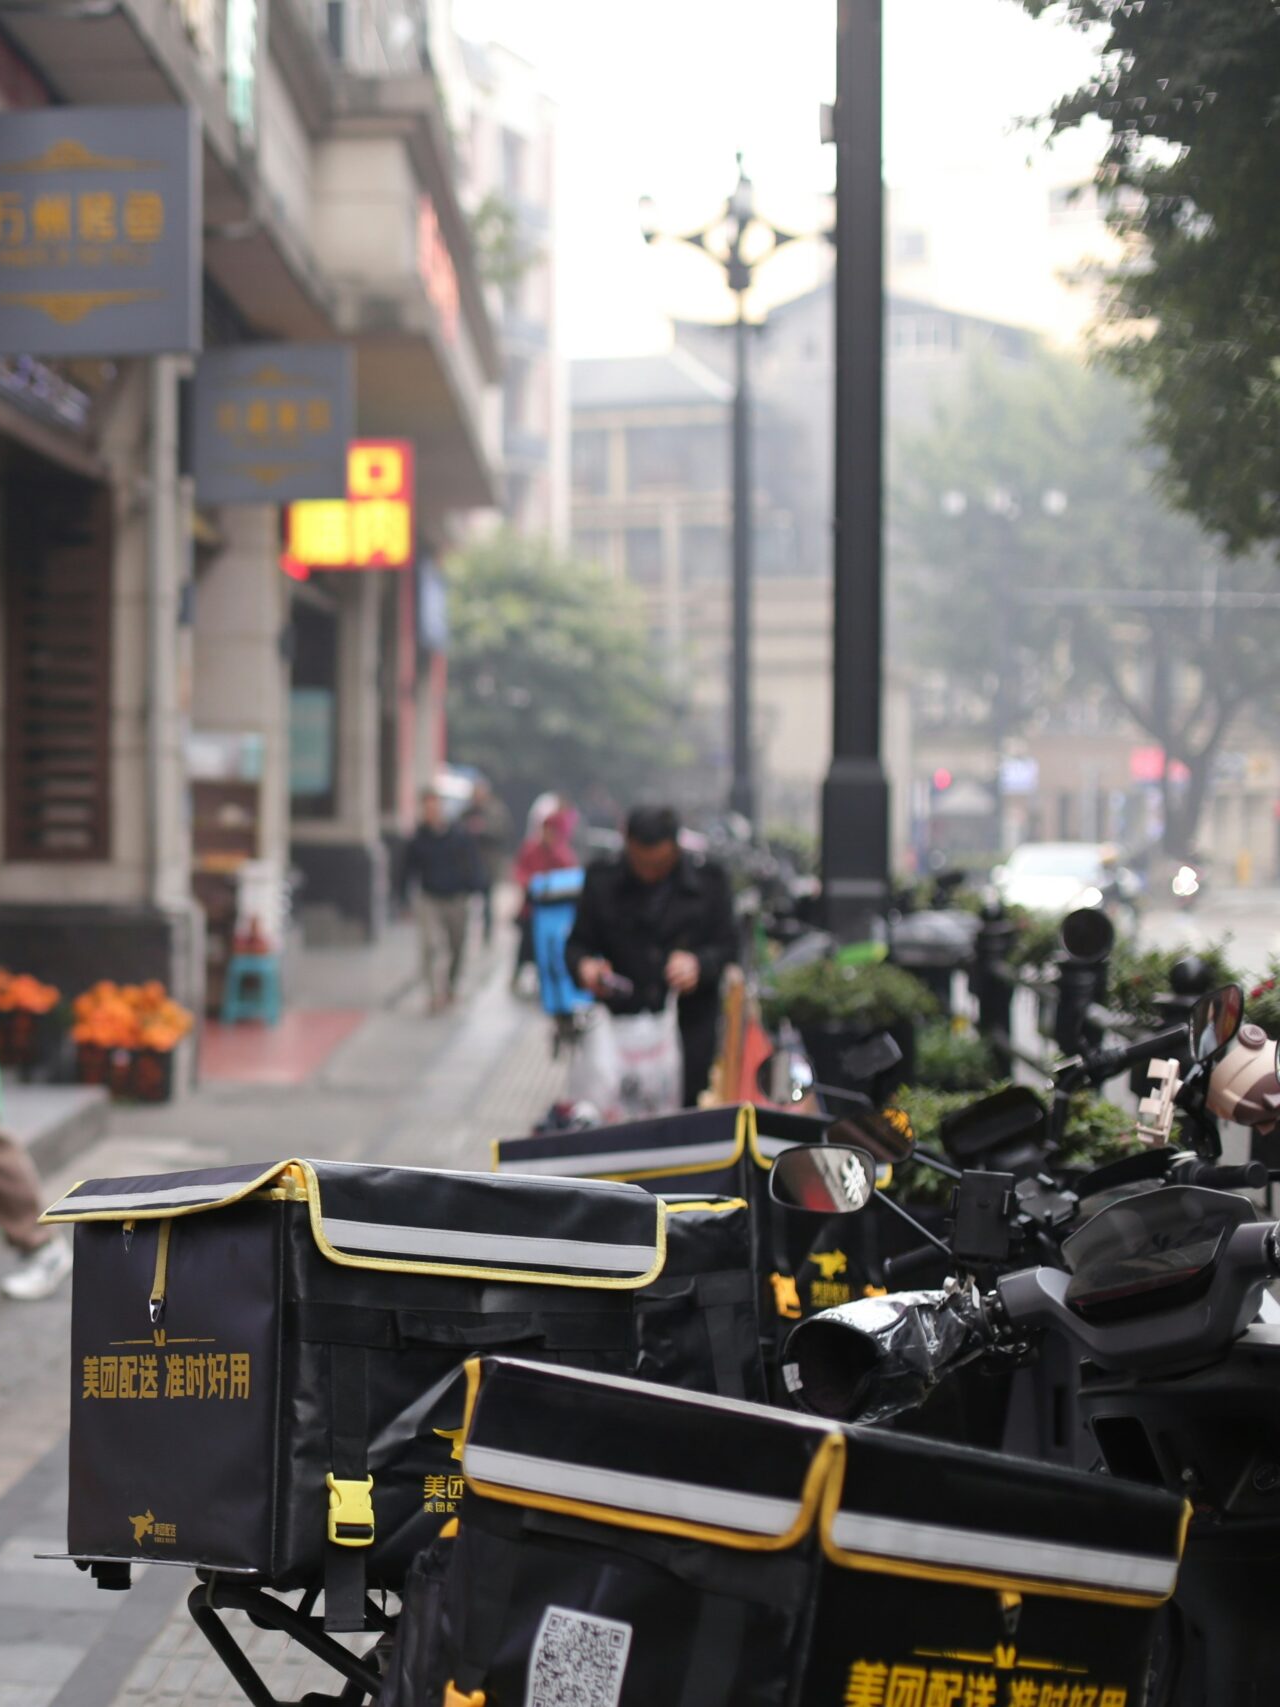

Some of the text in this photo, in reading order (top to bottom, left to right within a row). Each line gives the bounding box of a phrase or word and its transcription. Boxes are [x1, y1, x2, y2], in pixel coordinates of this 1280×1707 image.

[82, 1353, 250, 1399] 美团配送 准时好用
[424, 1475, 464, 1499] 美团
